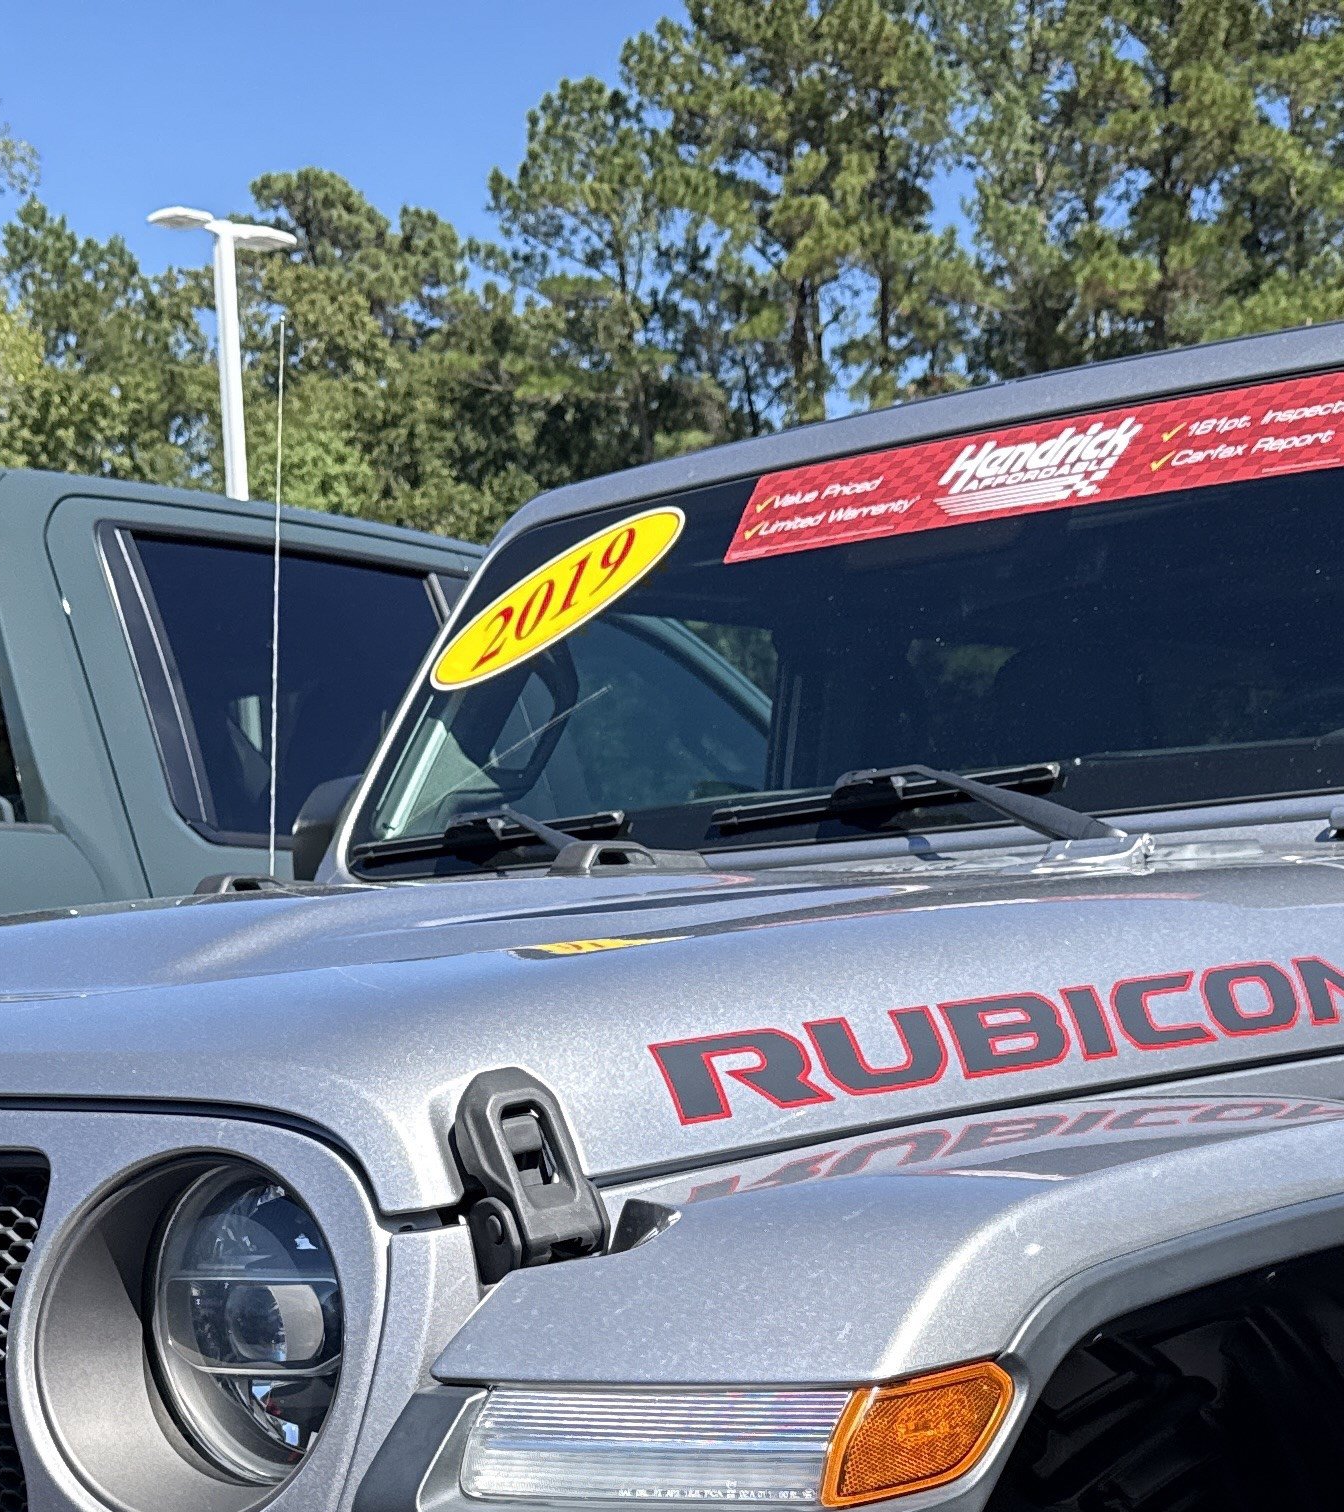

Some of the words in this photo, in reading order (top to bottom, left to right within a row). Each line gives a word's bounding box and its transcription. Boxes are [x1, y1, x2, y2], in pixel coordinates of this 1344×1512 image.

[938, 416, 1144, 495] Hendrick
[1170, 443, 1248, 467] Carfax
[1251, 429, 1336, 455] Report
[961, 455, 1119, 492] AFFORDABLE
[773, 489, 820, 510] Value
[820, 475, 885, 500] Priced
[758, 511, 826, 536] Limited
[469, 527, 637, 673] 2019
